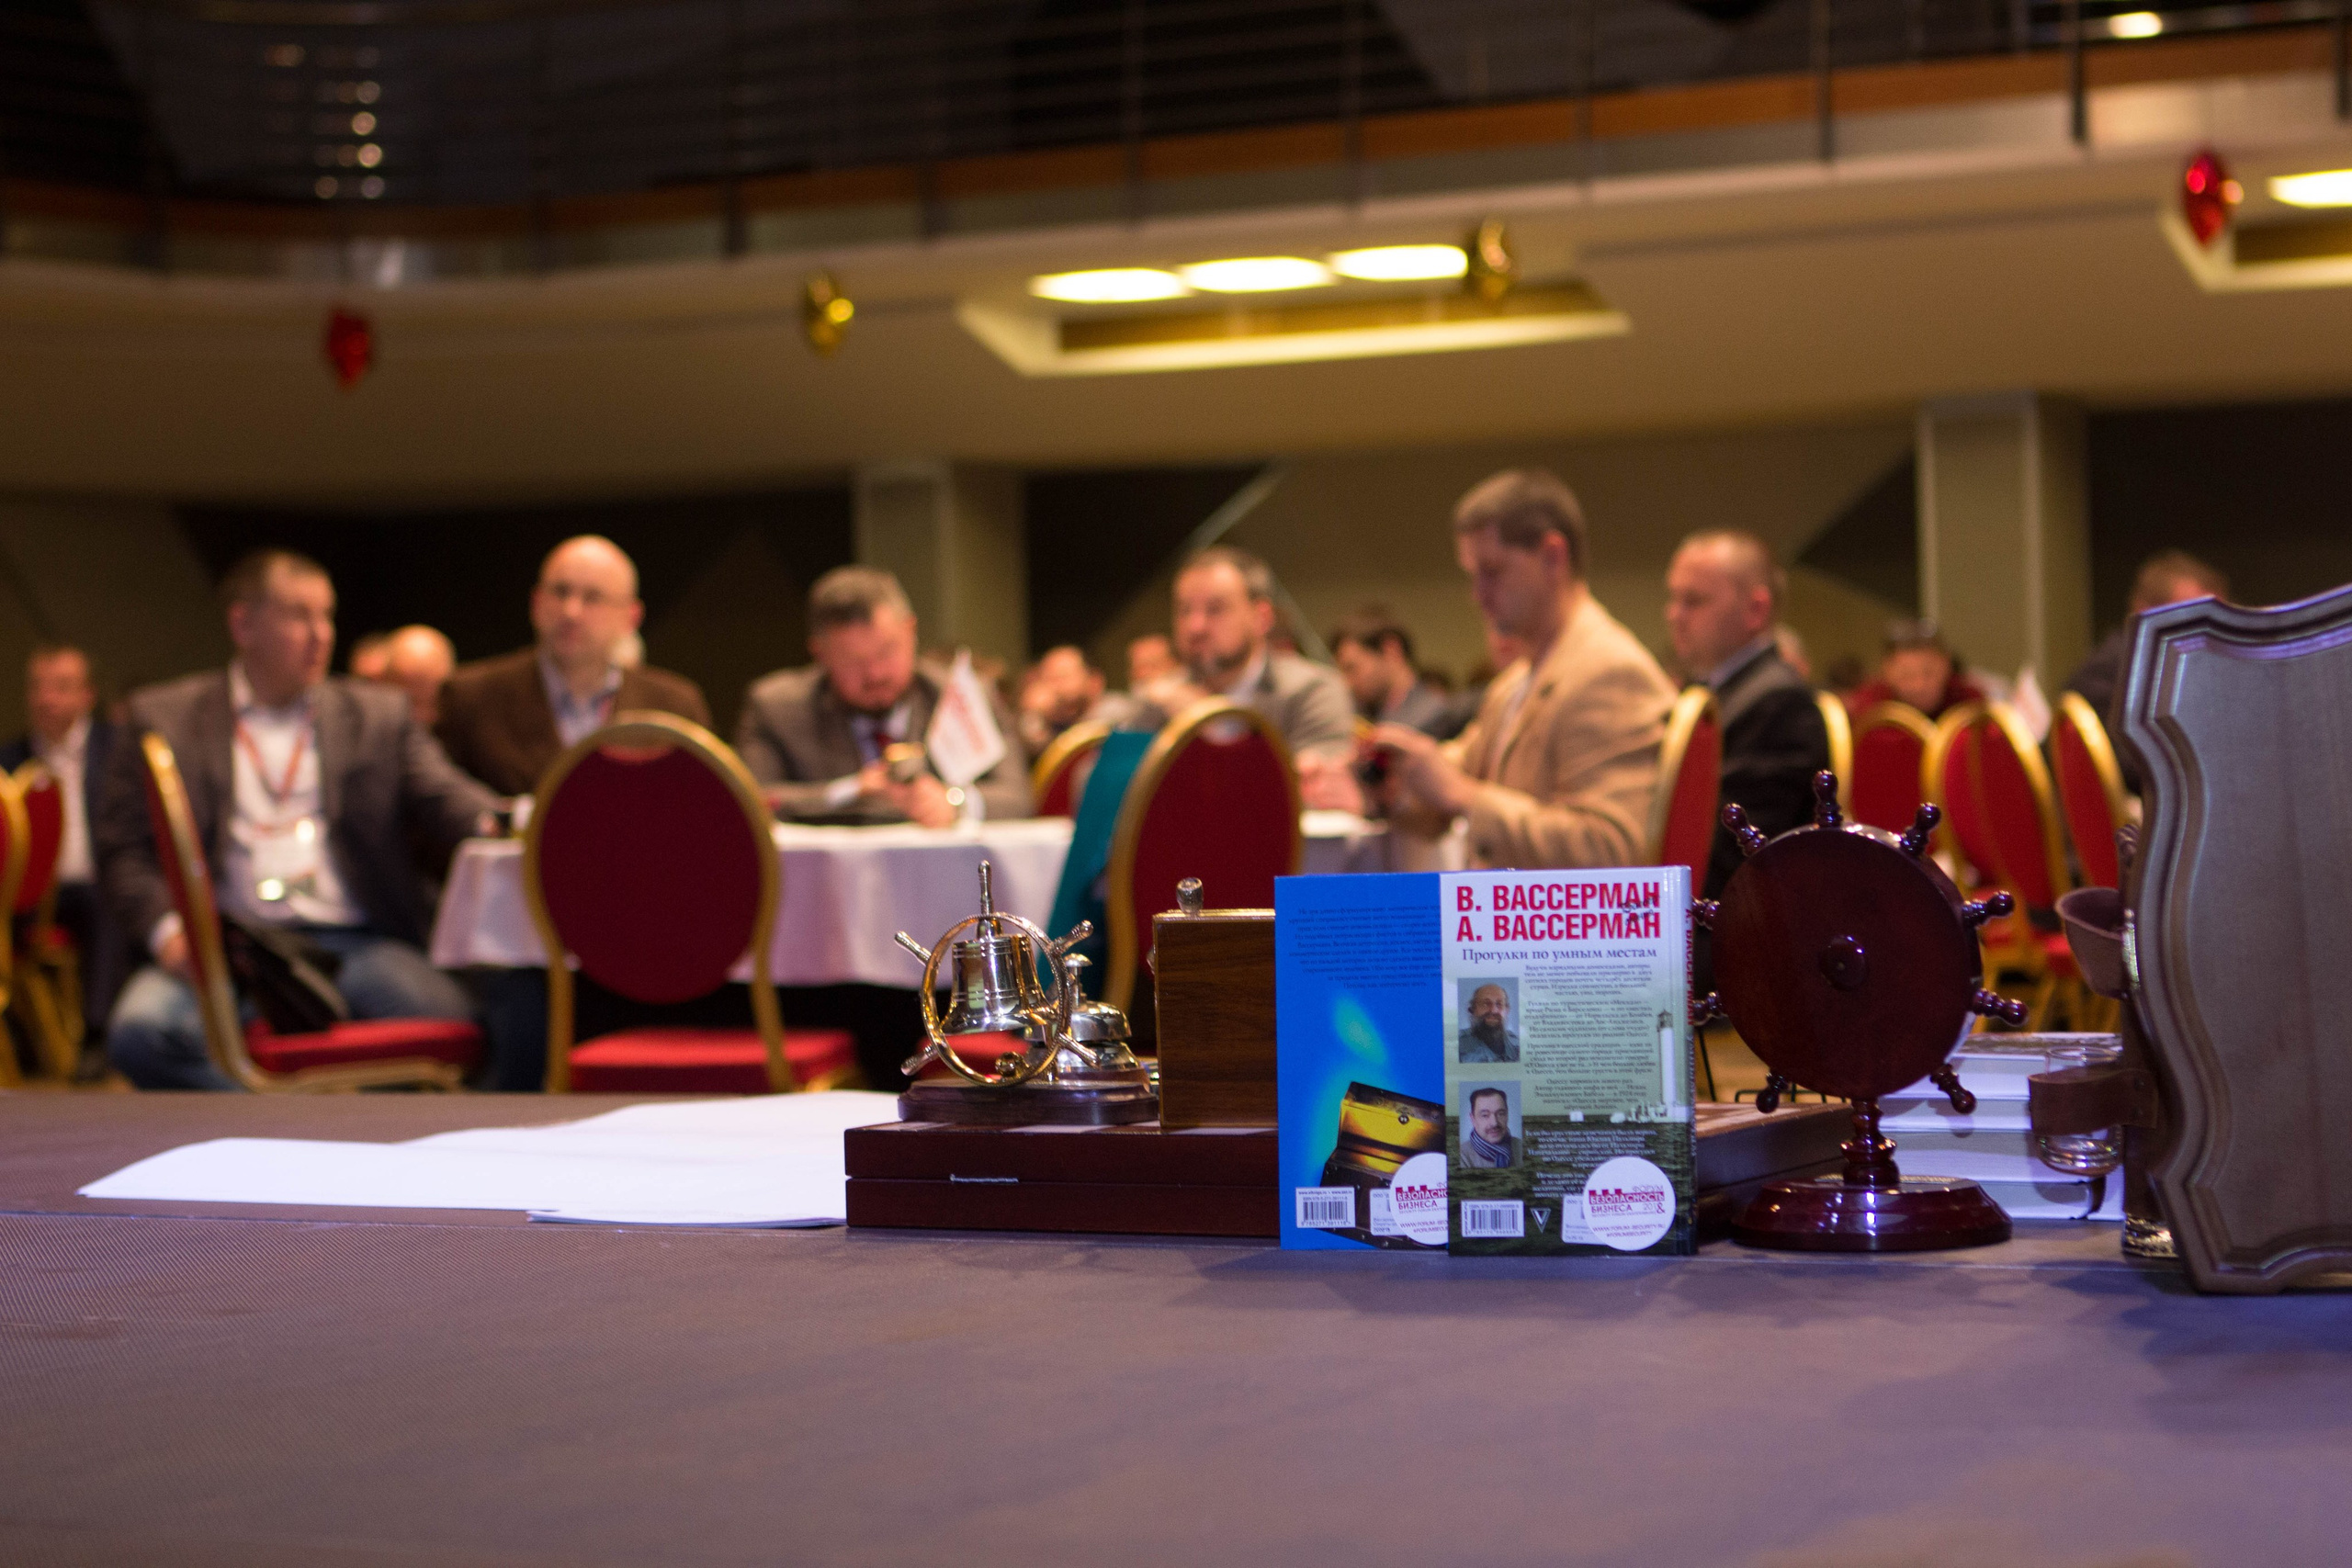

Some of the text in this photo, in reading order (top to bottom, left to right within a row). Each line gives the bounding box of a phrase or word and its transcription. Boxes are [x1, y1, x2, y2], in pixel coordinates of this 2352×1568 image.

[1456, 886, 1482, 912] В.
[1493, 882, 1660, 911] ВАССЕРМАН
[1456, 916, 1482, 942] А.
[1493, 912, 1661, 942] ВАССЕРМАН
[1462, 948, 1657, 964] Прогулки по умным местам
[1590, 1192, 1665, 1204] БЕЗОПАСНОСТЬ
[1398, 1200, 1438, 1211] БИЗНЕСА
[1591, 1203, 1633, 1213] БИЗНЕСА
